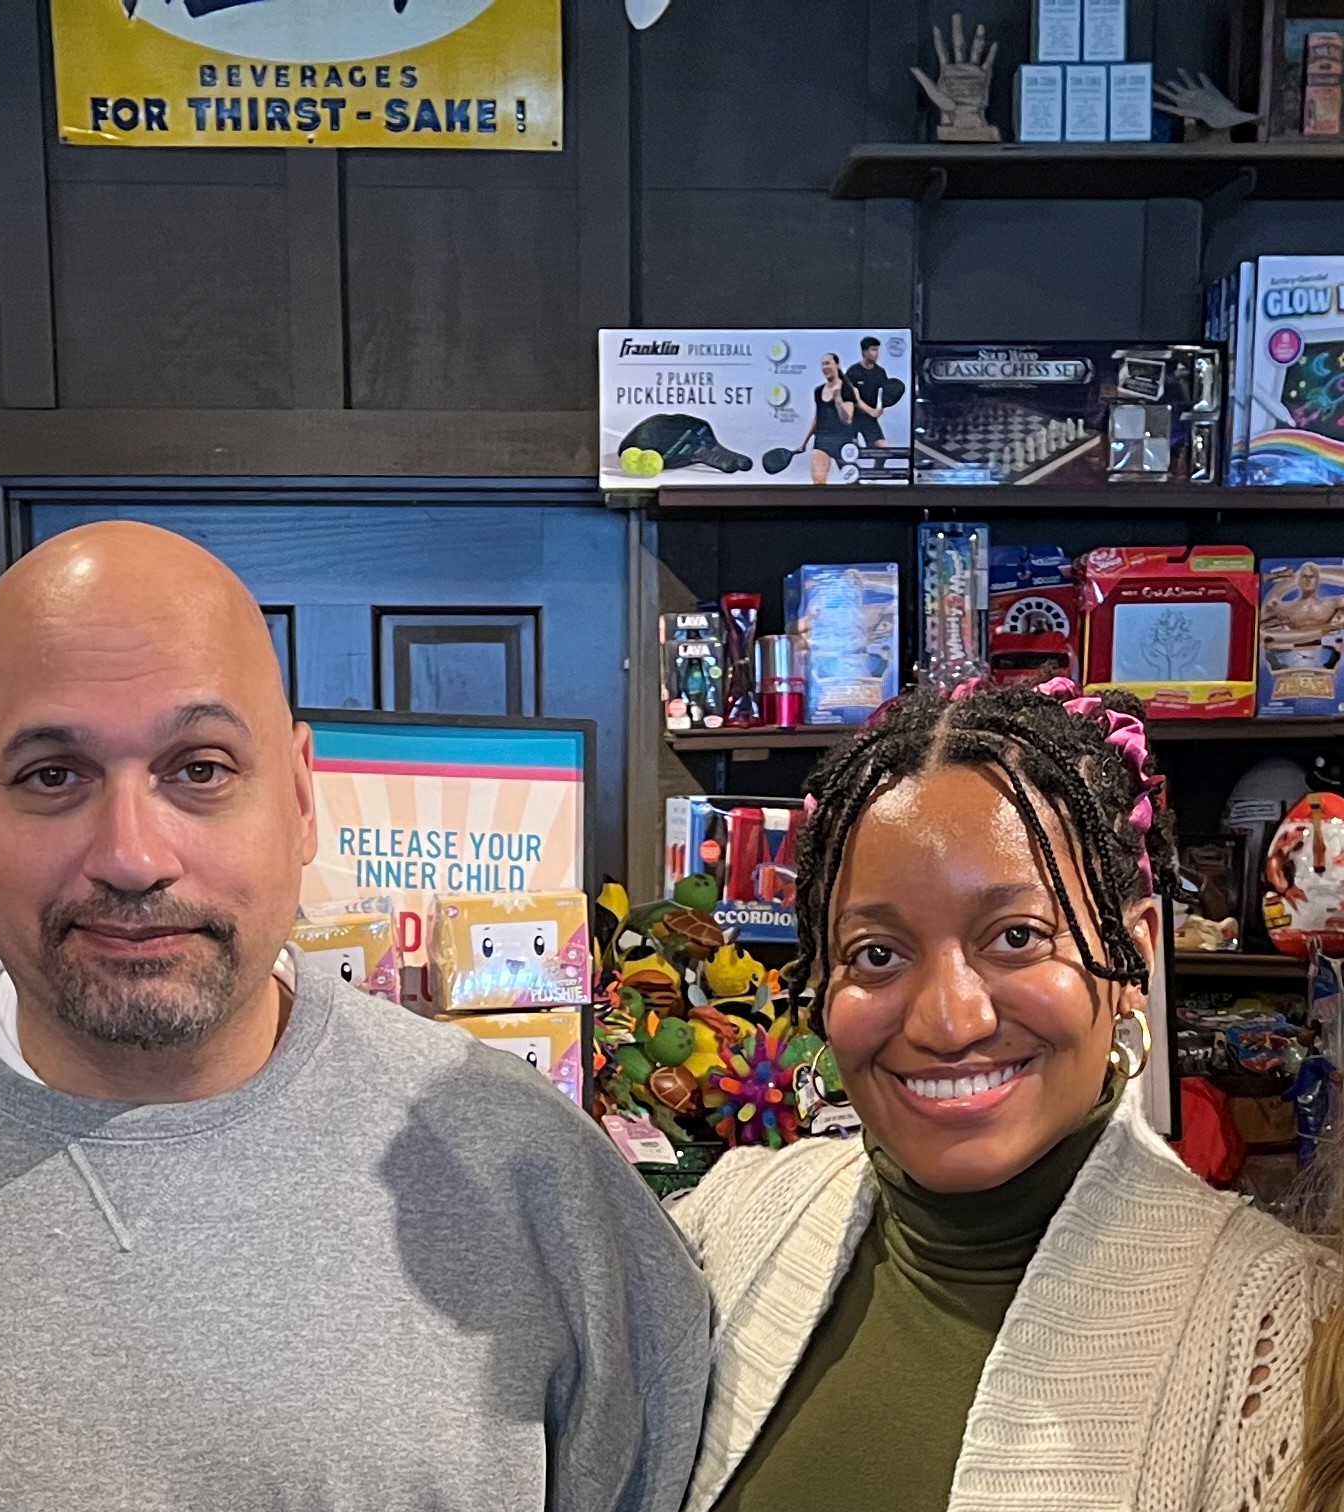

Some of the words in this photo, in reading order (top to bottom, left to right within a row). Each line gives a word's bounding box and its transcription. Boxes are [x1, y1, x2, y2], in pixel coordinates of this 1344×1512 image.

[199, 65, 419, 88] BEVERAGES
[91, 98, 168, 132] FOR
[1265, 287, 1331, 317] GLOW
[687, 343, 753, 357] PICKLEBALL
[933, 362, 998, 378] CLASSIC
[1000, 362, 1050, 377] CHESS
[1055, 362, 1083, 377] SET
[656, 372, 664, 386] 2
[668, 372, 714, 387] PLAYER
[617, 387, 717, 405] PICKLEBALL
[724, 387, 753, 405] SET
[677, 615, 709, 628] LAVA
[679, 645, 710, 657] LAVA
[339, 828, 458, 860] RELEASE
[470, 832, 542, 862] YOUR
[356, 861, 436, 890] INNER
[447, 863, 526, 892] CHILD
[714, 910, 793, 926] CCORDIO
